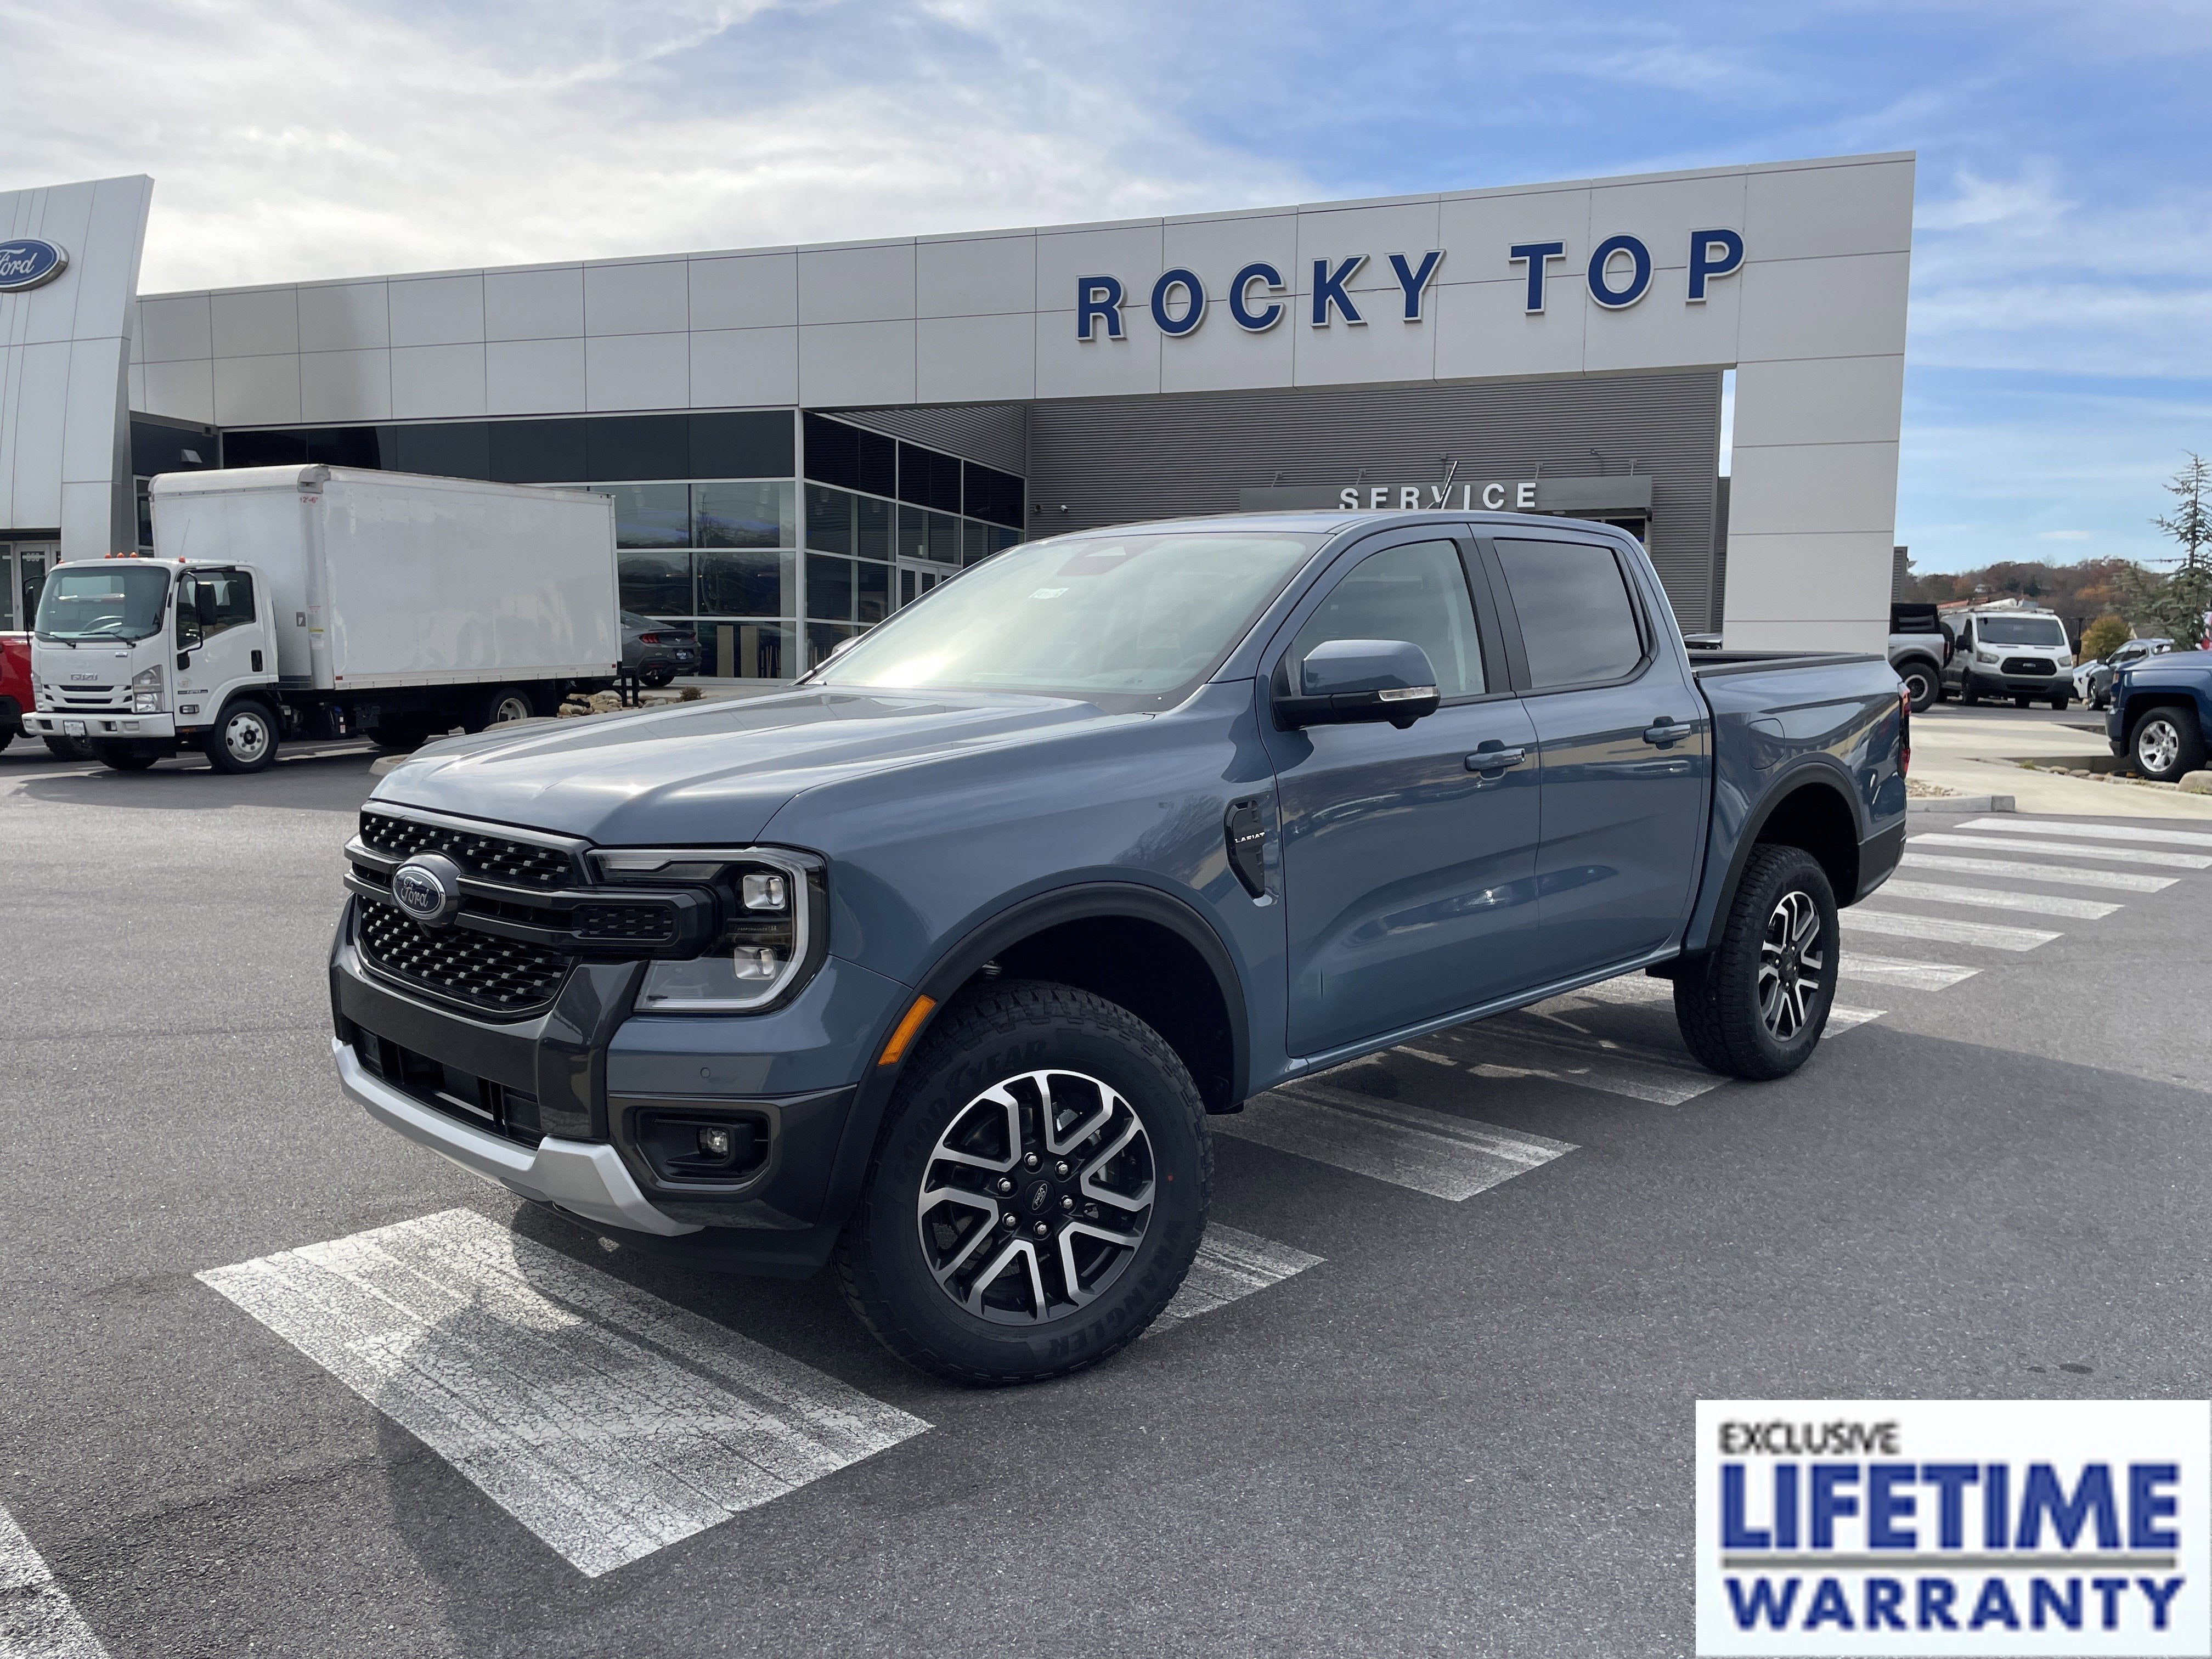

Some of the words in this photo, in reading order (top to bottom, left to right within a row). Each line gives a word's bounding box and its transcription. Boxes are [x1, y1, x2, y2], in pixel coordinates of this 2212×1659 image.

[0, 247, 38, 276] Ford
[1076, 250, 1444, 340] ROCKY
[1510, 227, 1746, 313] TOP
[1339, 482, 1536, 510] SERVICE
[1234, 832, 1265, 843] LARIAT
[400, 876, 430, 908] Ford
[1034, 1187, 1046, 1206] Ford
[1048, 1220, 1186, 1358] WRANGLER
